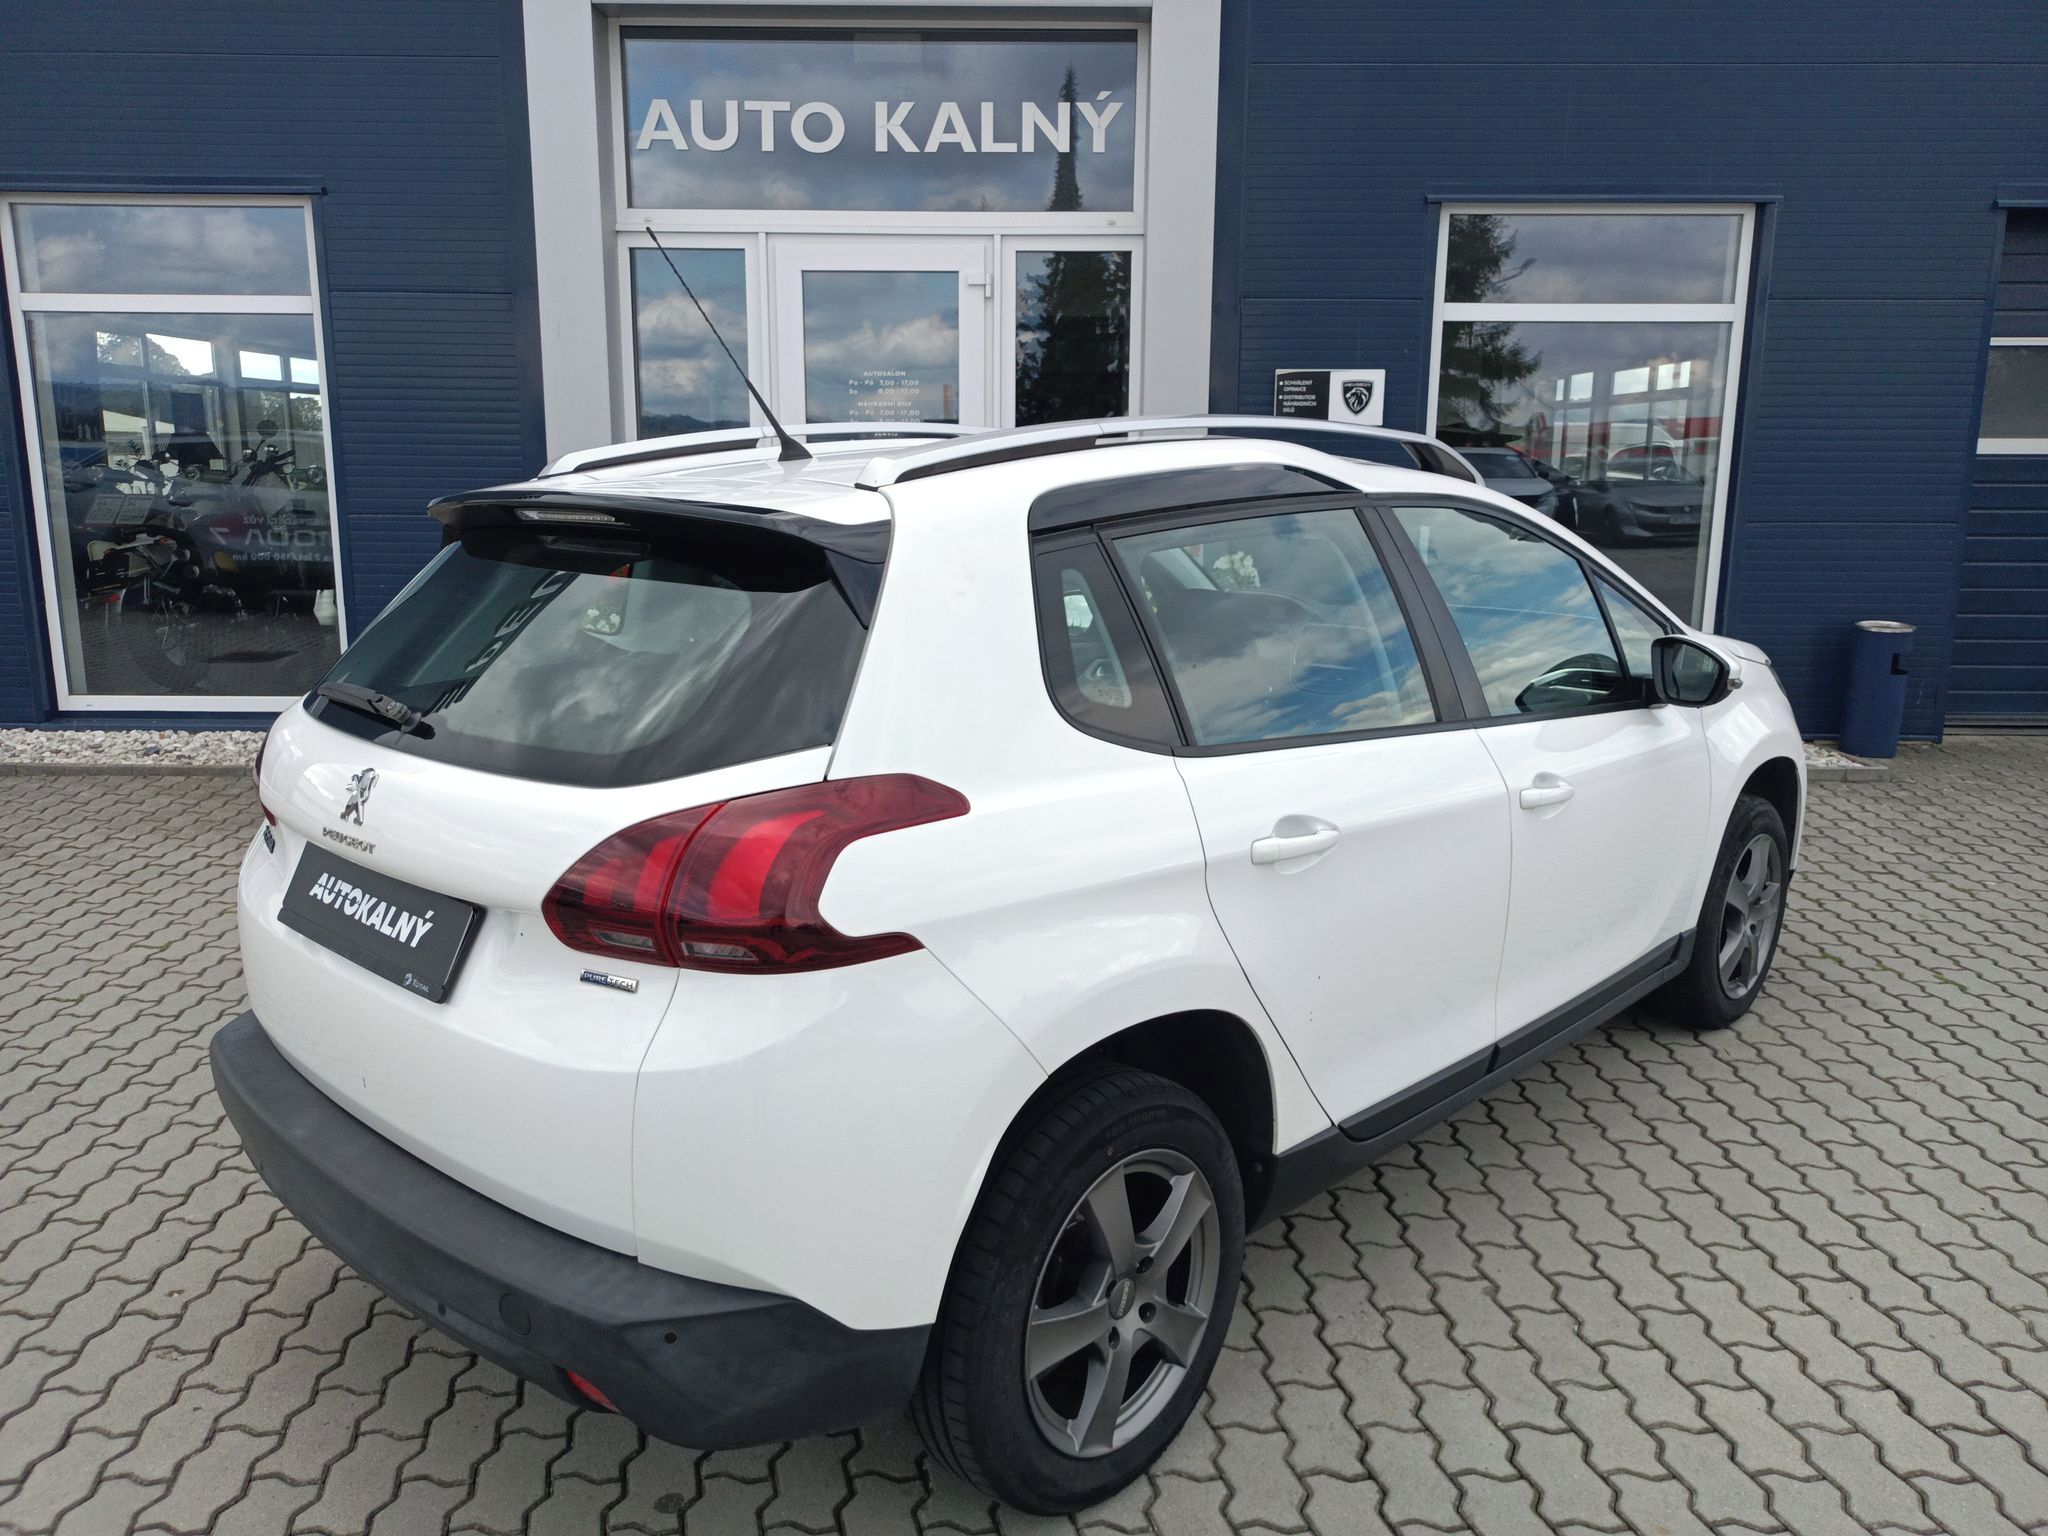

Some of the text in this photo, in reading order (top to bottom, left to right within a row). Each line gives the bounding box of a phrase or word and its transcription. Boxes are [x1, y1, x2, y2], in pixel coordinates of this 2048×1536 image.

[636, 91, 1125, 154] AUTO KALNÝ
[322, 827, 376, 854] PEUGEOT
[309, 872, 434, 948] AUTOKALNÝ
